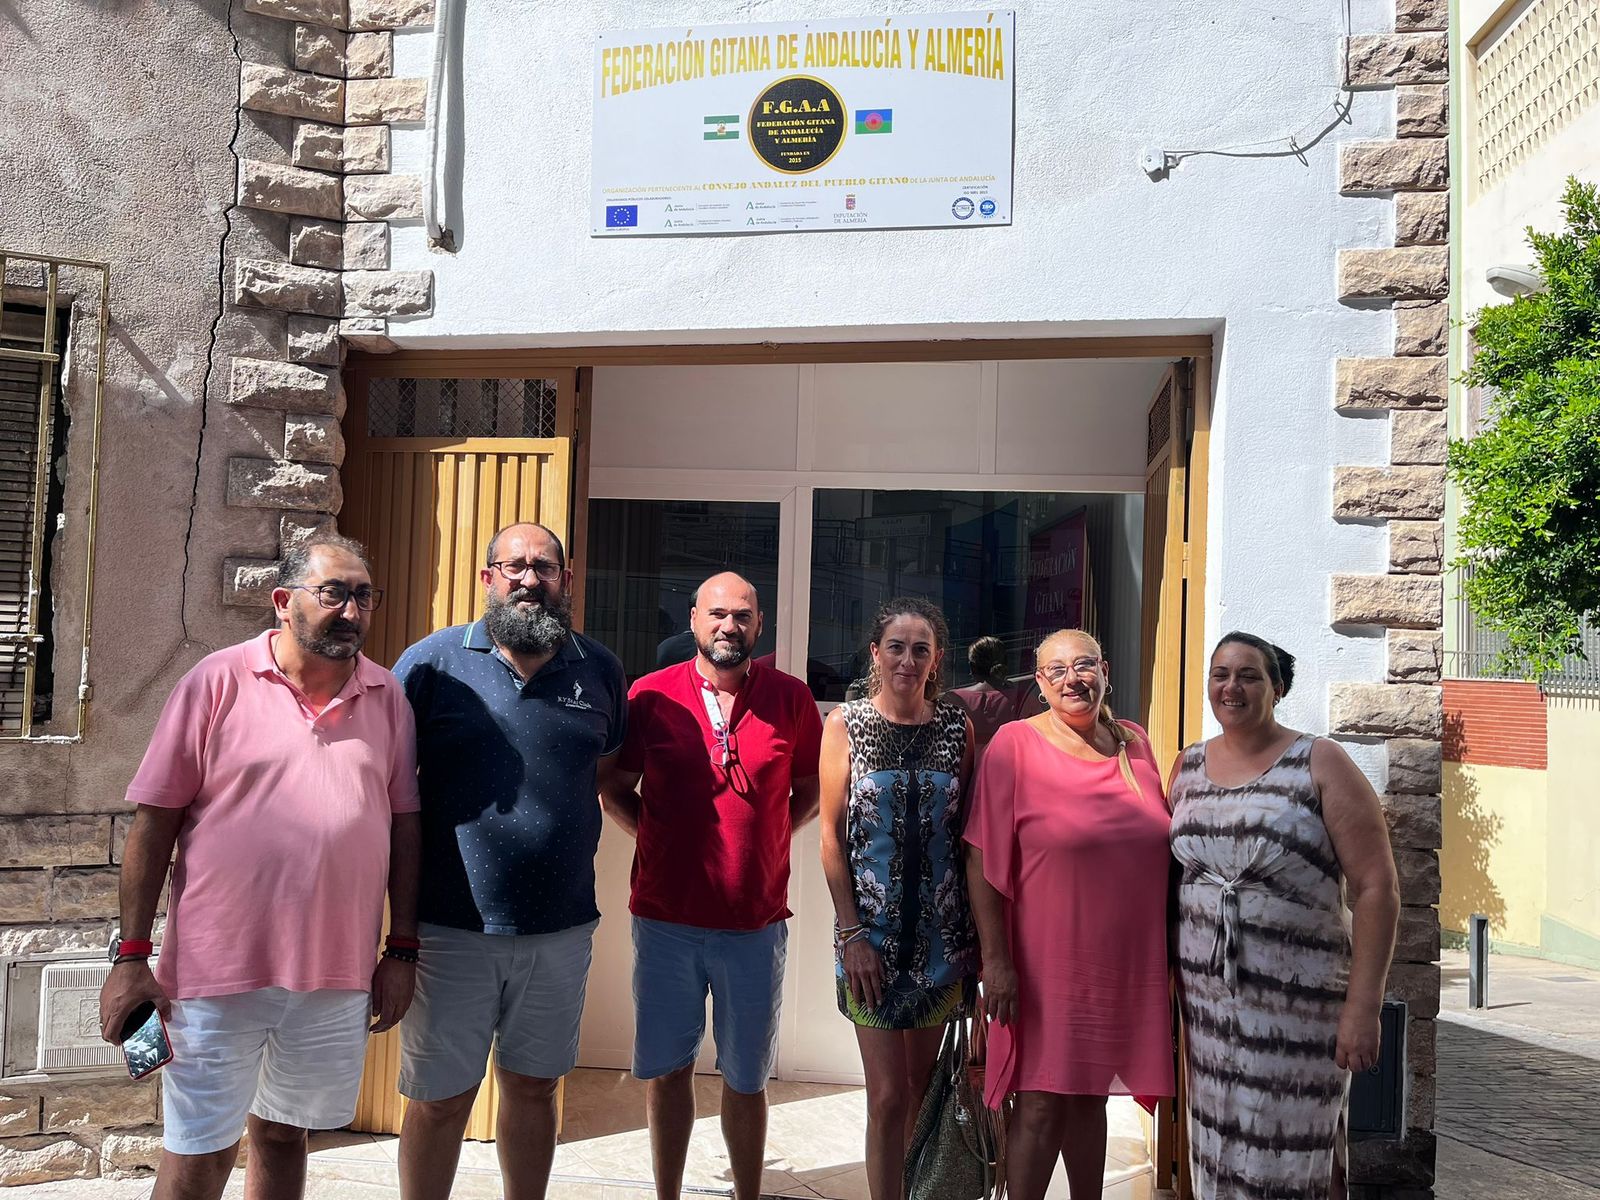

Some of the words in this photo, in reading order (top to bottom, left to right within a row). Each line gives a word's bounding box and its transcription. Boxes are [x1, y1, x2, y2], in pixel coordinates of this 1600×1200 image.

[602, 29, 705, 98] FEDERACIÓN
[710, 36, 771, 77] GITANA
[776, 33, 799, 69] DE
[803, 18, 902, 69] ANDALUCÍA
[907, 28, 920, 69] Y
[924, 13, 1004, 80] ALMERÍA
[762, 99, 830, 114] F.G.A.A
[757, 119, 805, 128] FEDERACIÓN
[806, 118, 836, 126] GITANA
[780, 127, 824, 136] ANDALUCÍA
[781, 136, 817, 144] ALMERÍA
[602, 184, 647, 194] ORGANIZACIÓN
[647, 184, 692, 193] PERTENECIENTE
[702, 181, 747, 191] CONSEJO
[751, 180, 798, 190] ANDALUZ
[800, 179, 820, 188] DEL
[824, 178, 866, 187] PUEBLO
[869, 177, 909, 186] GITANO
[833, 211, 868, 219] DIPUTACIÓN
